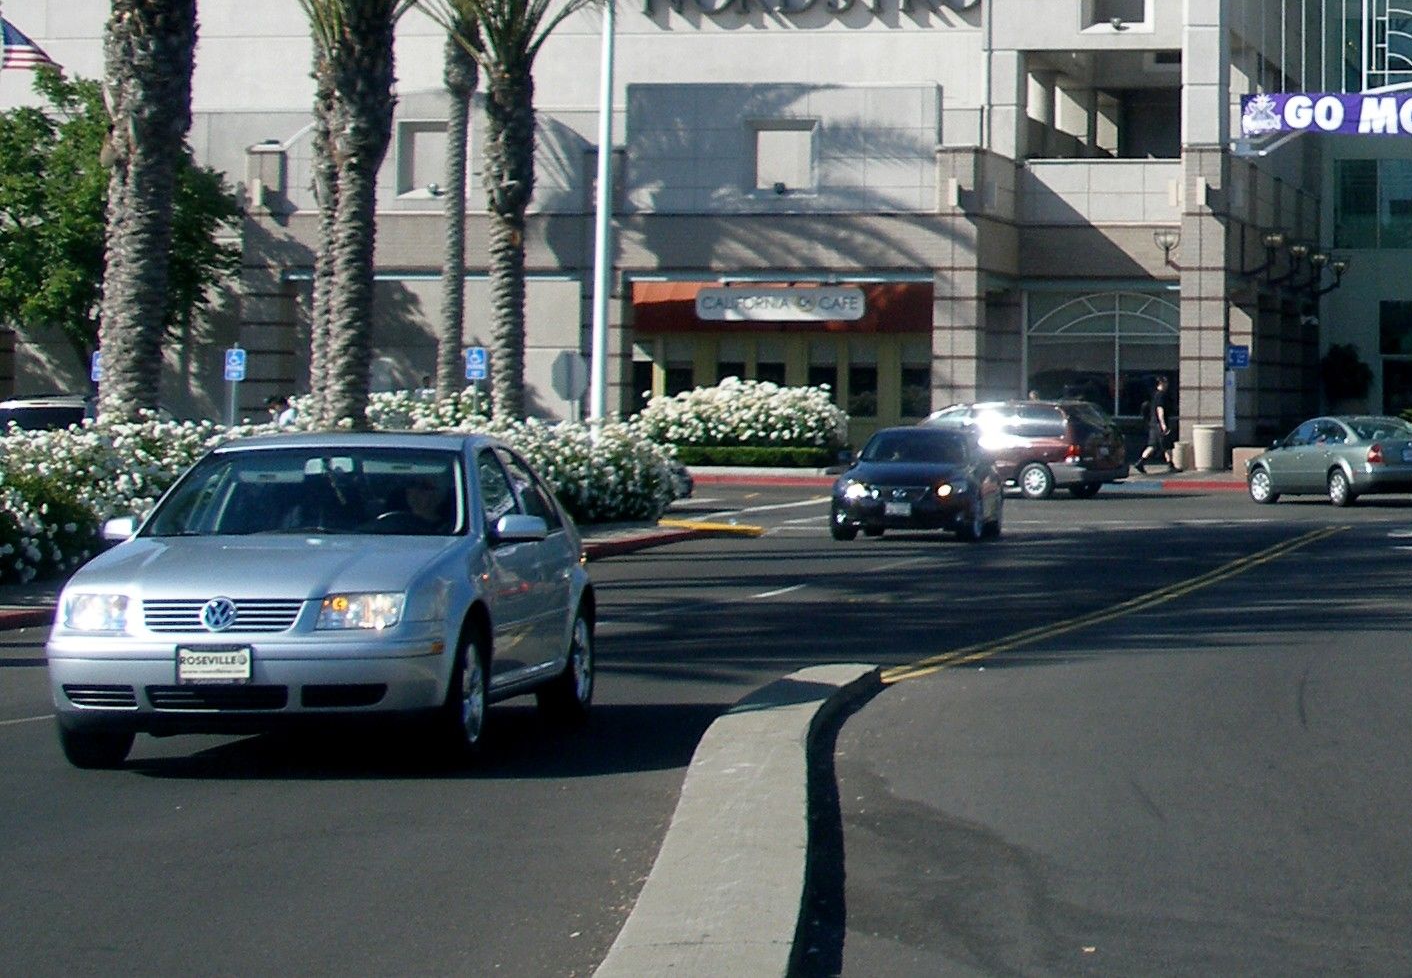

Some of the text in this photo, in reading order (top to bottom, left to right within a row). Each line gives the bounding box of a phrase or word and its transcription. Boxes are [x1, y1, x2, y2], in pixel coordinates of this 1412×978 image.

[1283, 95, 1344, 131] GO
[702, 295, 858, 310] CALIFORNIA CAFE
[179, 655, 236, 665] ROSEVILLE
